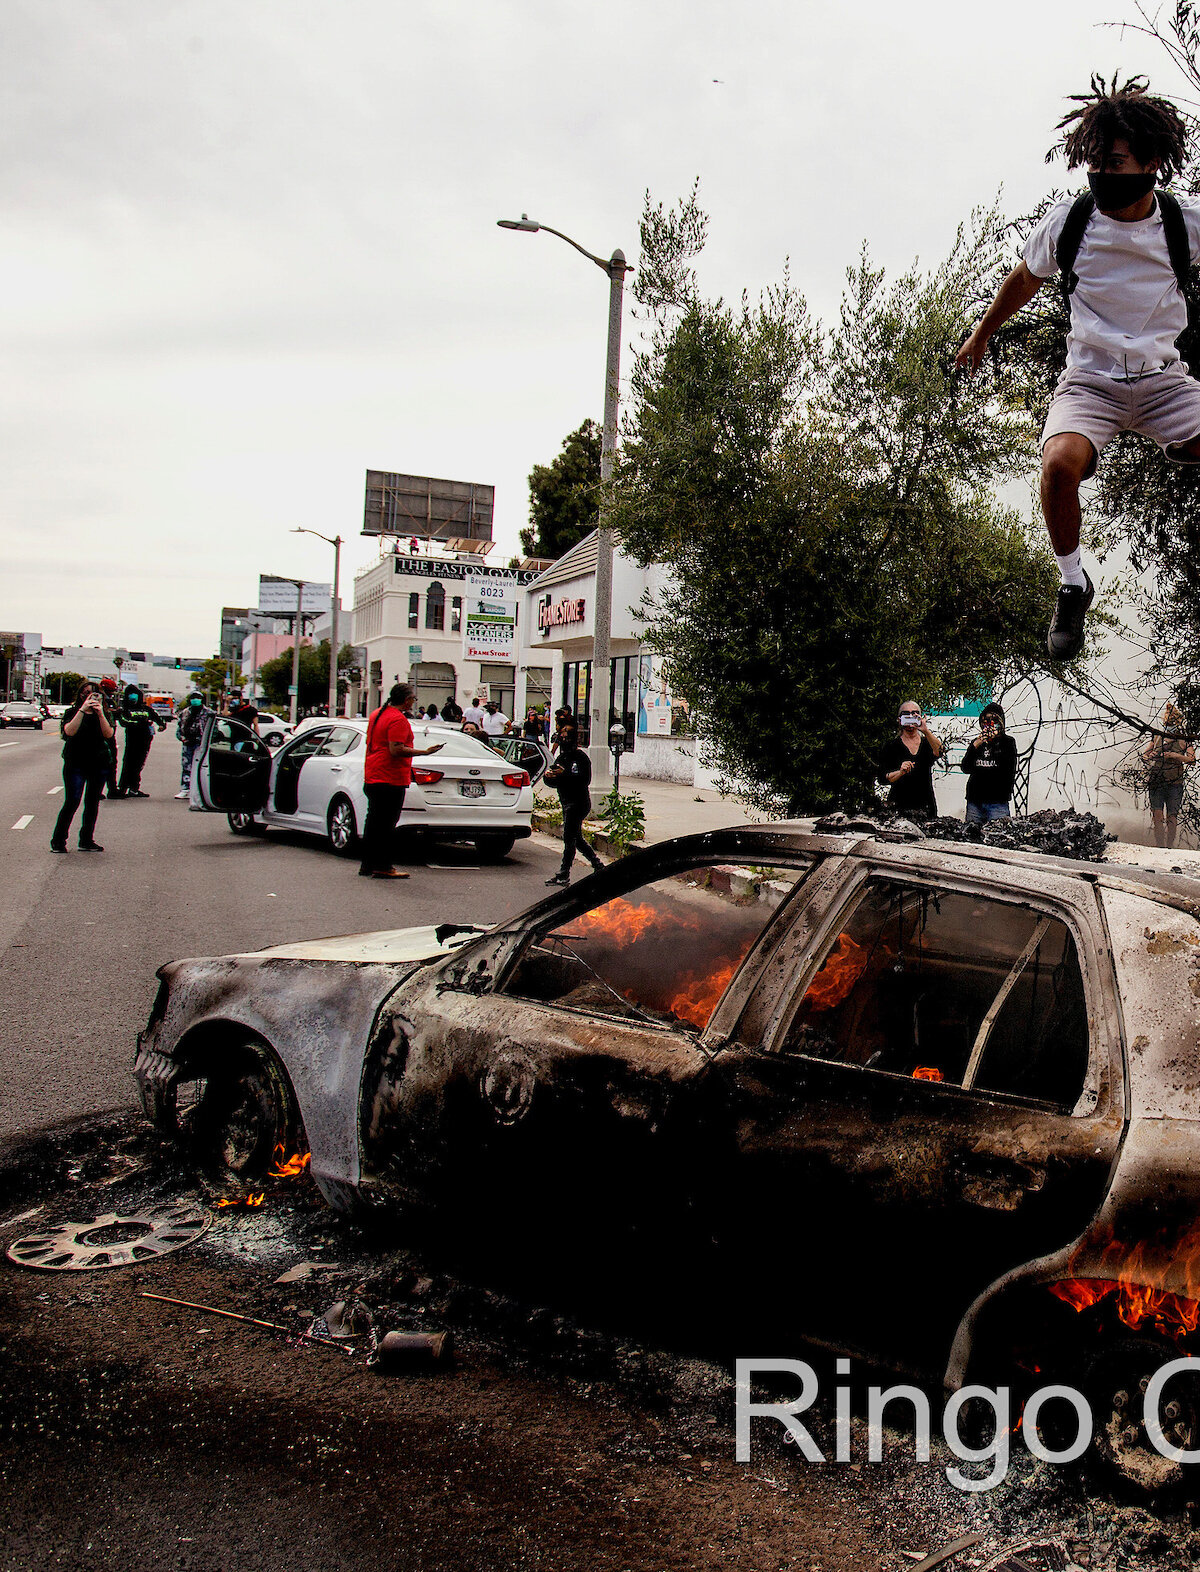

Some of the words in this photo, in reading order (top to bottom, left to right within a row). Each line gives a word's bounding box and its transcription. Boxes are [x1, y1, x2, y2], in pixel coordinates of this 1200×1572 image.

[398, 558, 429, 571] THE
[433, 562, 485, 576] EASTON
[488, 568, 519, 579] GYM
[480, 587, 504, 598] 8023
[467, 629, 513, 639] CLEANERS
